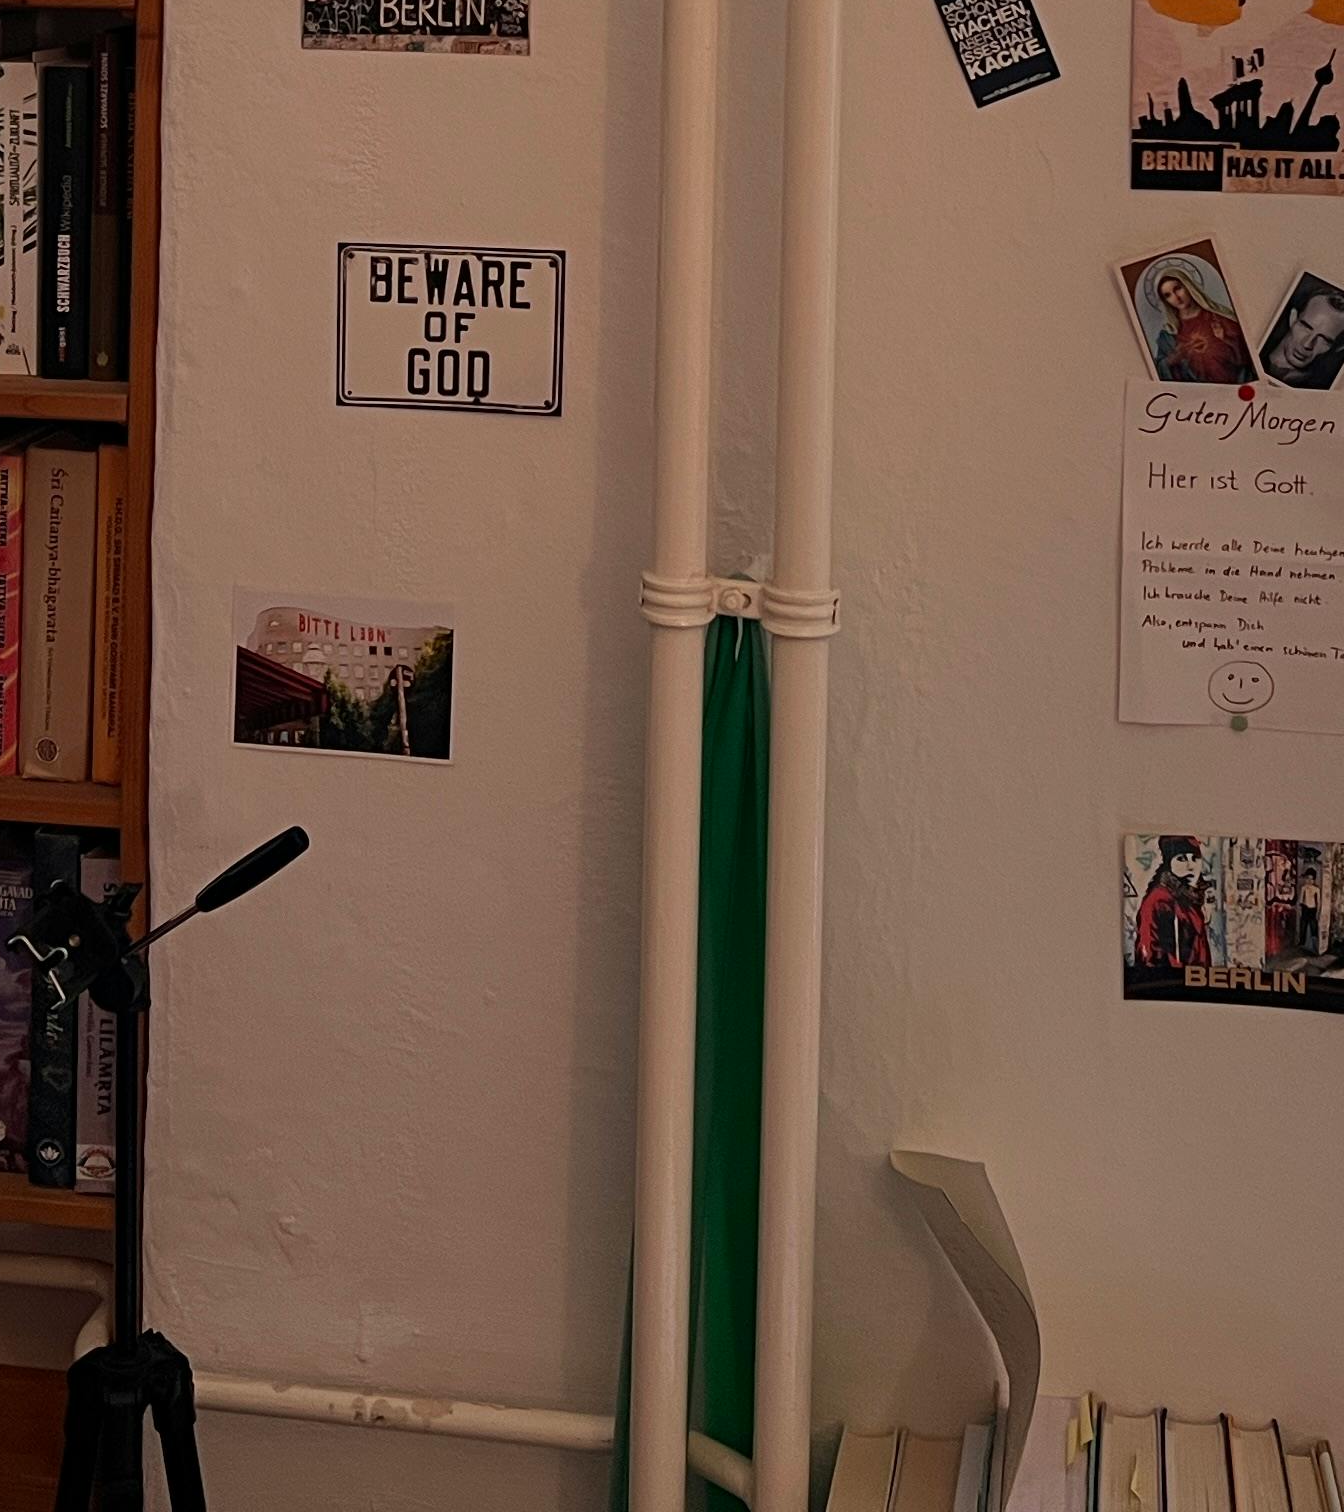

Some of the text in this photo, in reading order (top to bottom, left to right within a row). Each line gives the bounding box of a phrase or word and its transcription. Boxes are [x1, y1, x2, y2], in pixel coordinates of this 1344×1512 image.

[941, 0, 964, 15] DAS
[950, 1, 1031, 42] MACHEN,
[958, 16, 1032, 52] ABER DANN
[1001, 27, 1033, 48] HALT
[965, 38, 1046, 80] KACKE
[100, 52, 109, 129] SCHWARZE SONNE
[1142, 151, 1214, 171] BERLIN
[1227, 157, 1267, 178] HAS
[1275, 158, 1295, 178] IT
[57, 175, 73, 313] SCHWARZBUCH Wikipedia
[370, 254, 532, 309] BEWARE
[425, 311, 475, 343] OF
[408, 348, 490, 398] GOD
[1138, 393, 1229, 433] Guten
[1149, 462, 1198, 489] Hier
[1211, 470, 1239, 490] ist
[44, 468, 69, 643] Śrī Caitanya-bhāgavata
[1141, 532, 1344, 559] Ich werde alle Deine heutigen
[1142, 560, 1194, 573] Probleme
[1205, 566, 1215, 575] in
[1223, 566, 1240, 576] die
[1250, 566, 1282, 578] Hand
[1144, 587, 1160, 600] Ich
[1165, 588, 1210, 602] brauche
[1220, 590, 1247, 605] Deine
[299, 614, 339, 639] BITTE
[1238, 618, 1264, 631] Dich
[1182, 639, 1205, 649] und
[1185, 965, 1306, 994] BERLIN
